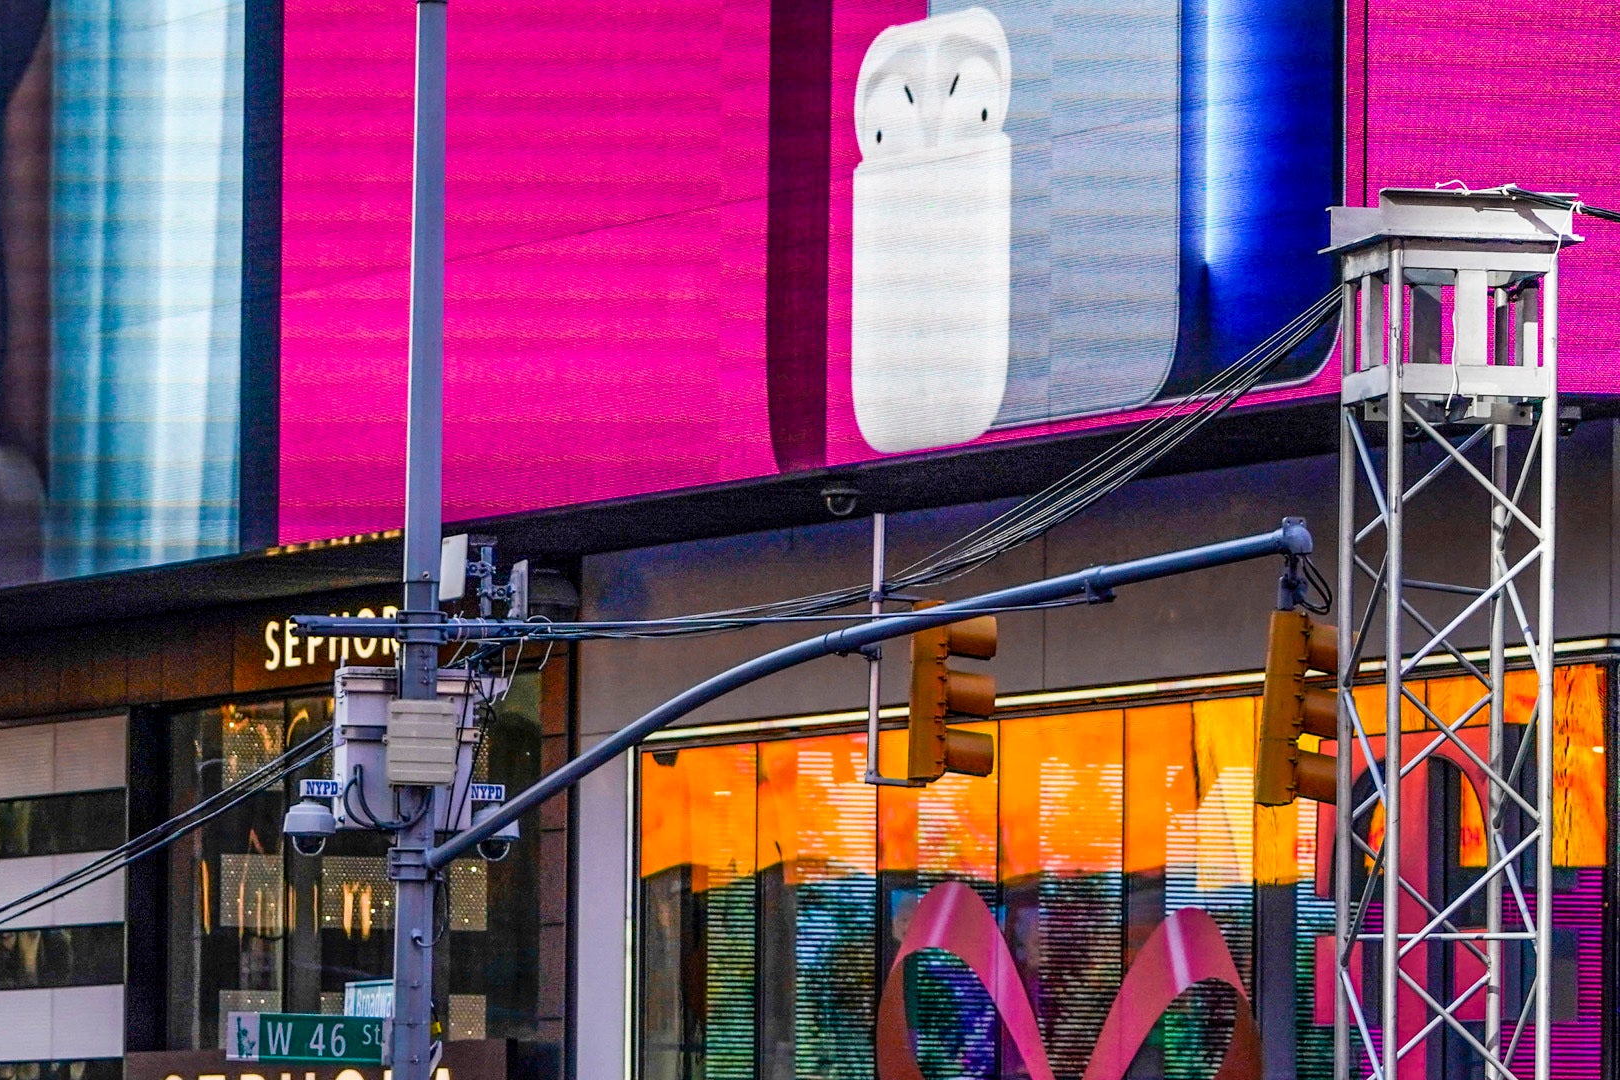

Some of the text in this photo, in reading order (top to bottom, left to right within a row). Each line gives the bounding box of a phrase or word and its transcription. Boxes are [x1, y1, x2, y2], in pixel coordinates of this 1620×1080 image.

[306, 780, 338, 796] NYPD
[470, 786, 503, 801] NYPD
[356, 986, 393, 1018] Broadwa
[267, 1021, 293, 1056] W
[309, 1023, 347, 1058] 46
